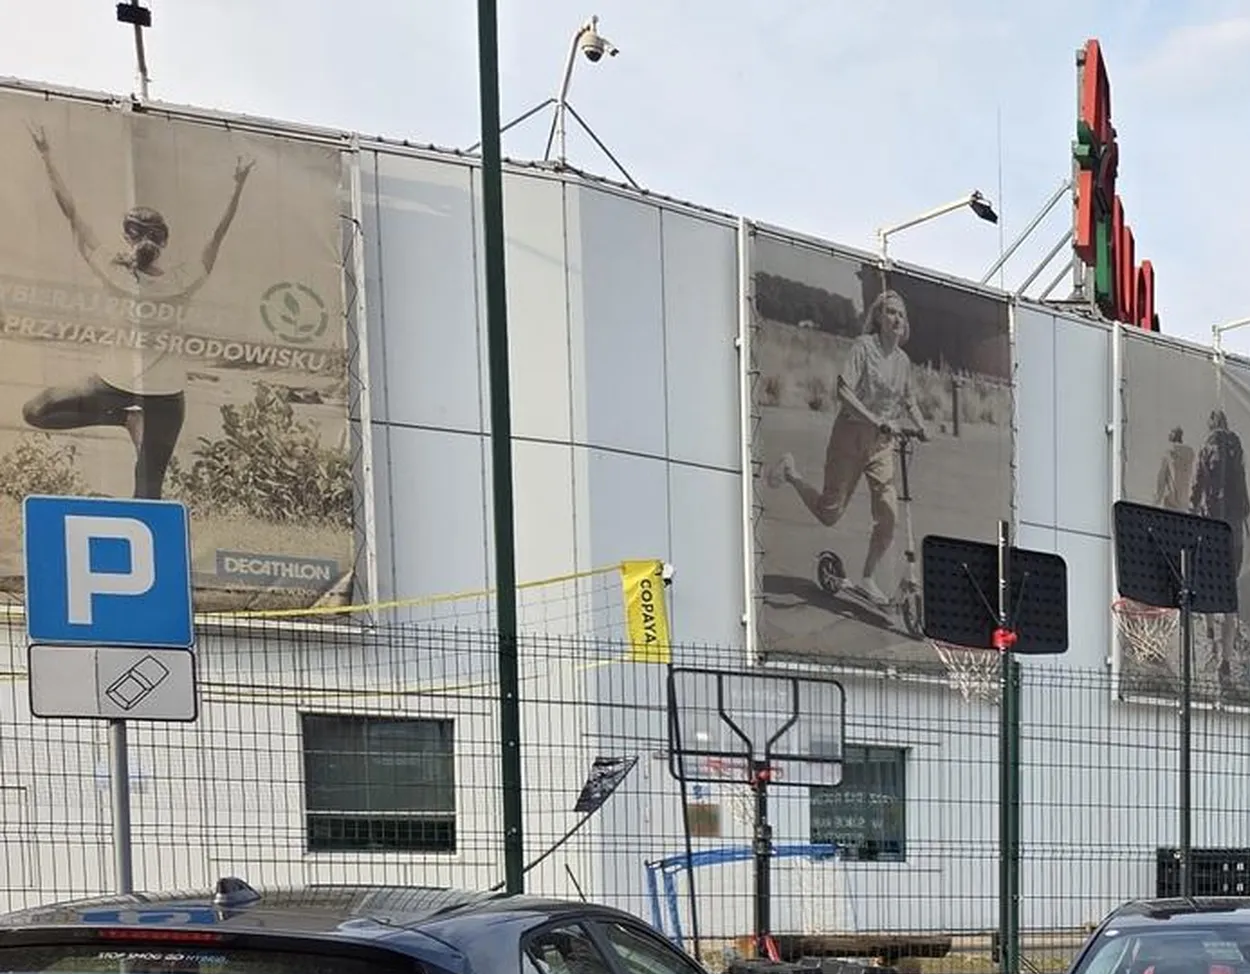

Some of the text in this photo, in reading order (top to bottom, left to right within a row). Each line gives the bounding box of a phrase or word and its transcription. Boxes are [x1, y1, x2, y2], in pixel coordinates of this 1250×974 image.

[4, 314, 330, 372] PRZYJAZNE ŚRODOWISKU
[64, 515, 156, 625] P
[223, 556, 331, 580] DECATHLON
[640, 579, 657, 643] COPAYA
